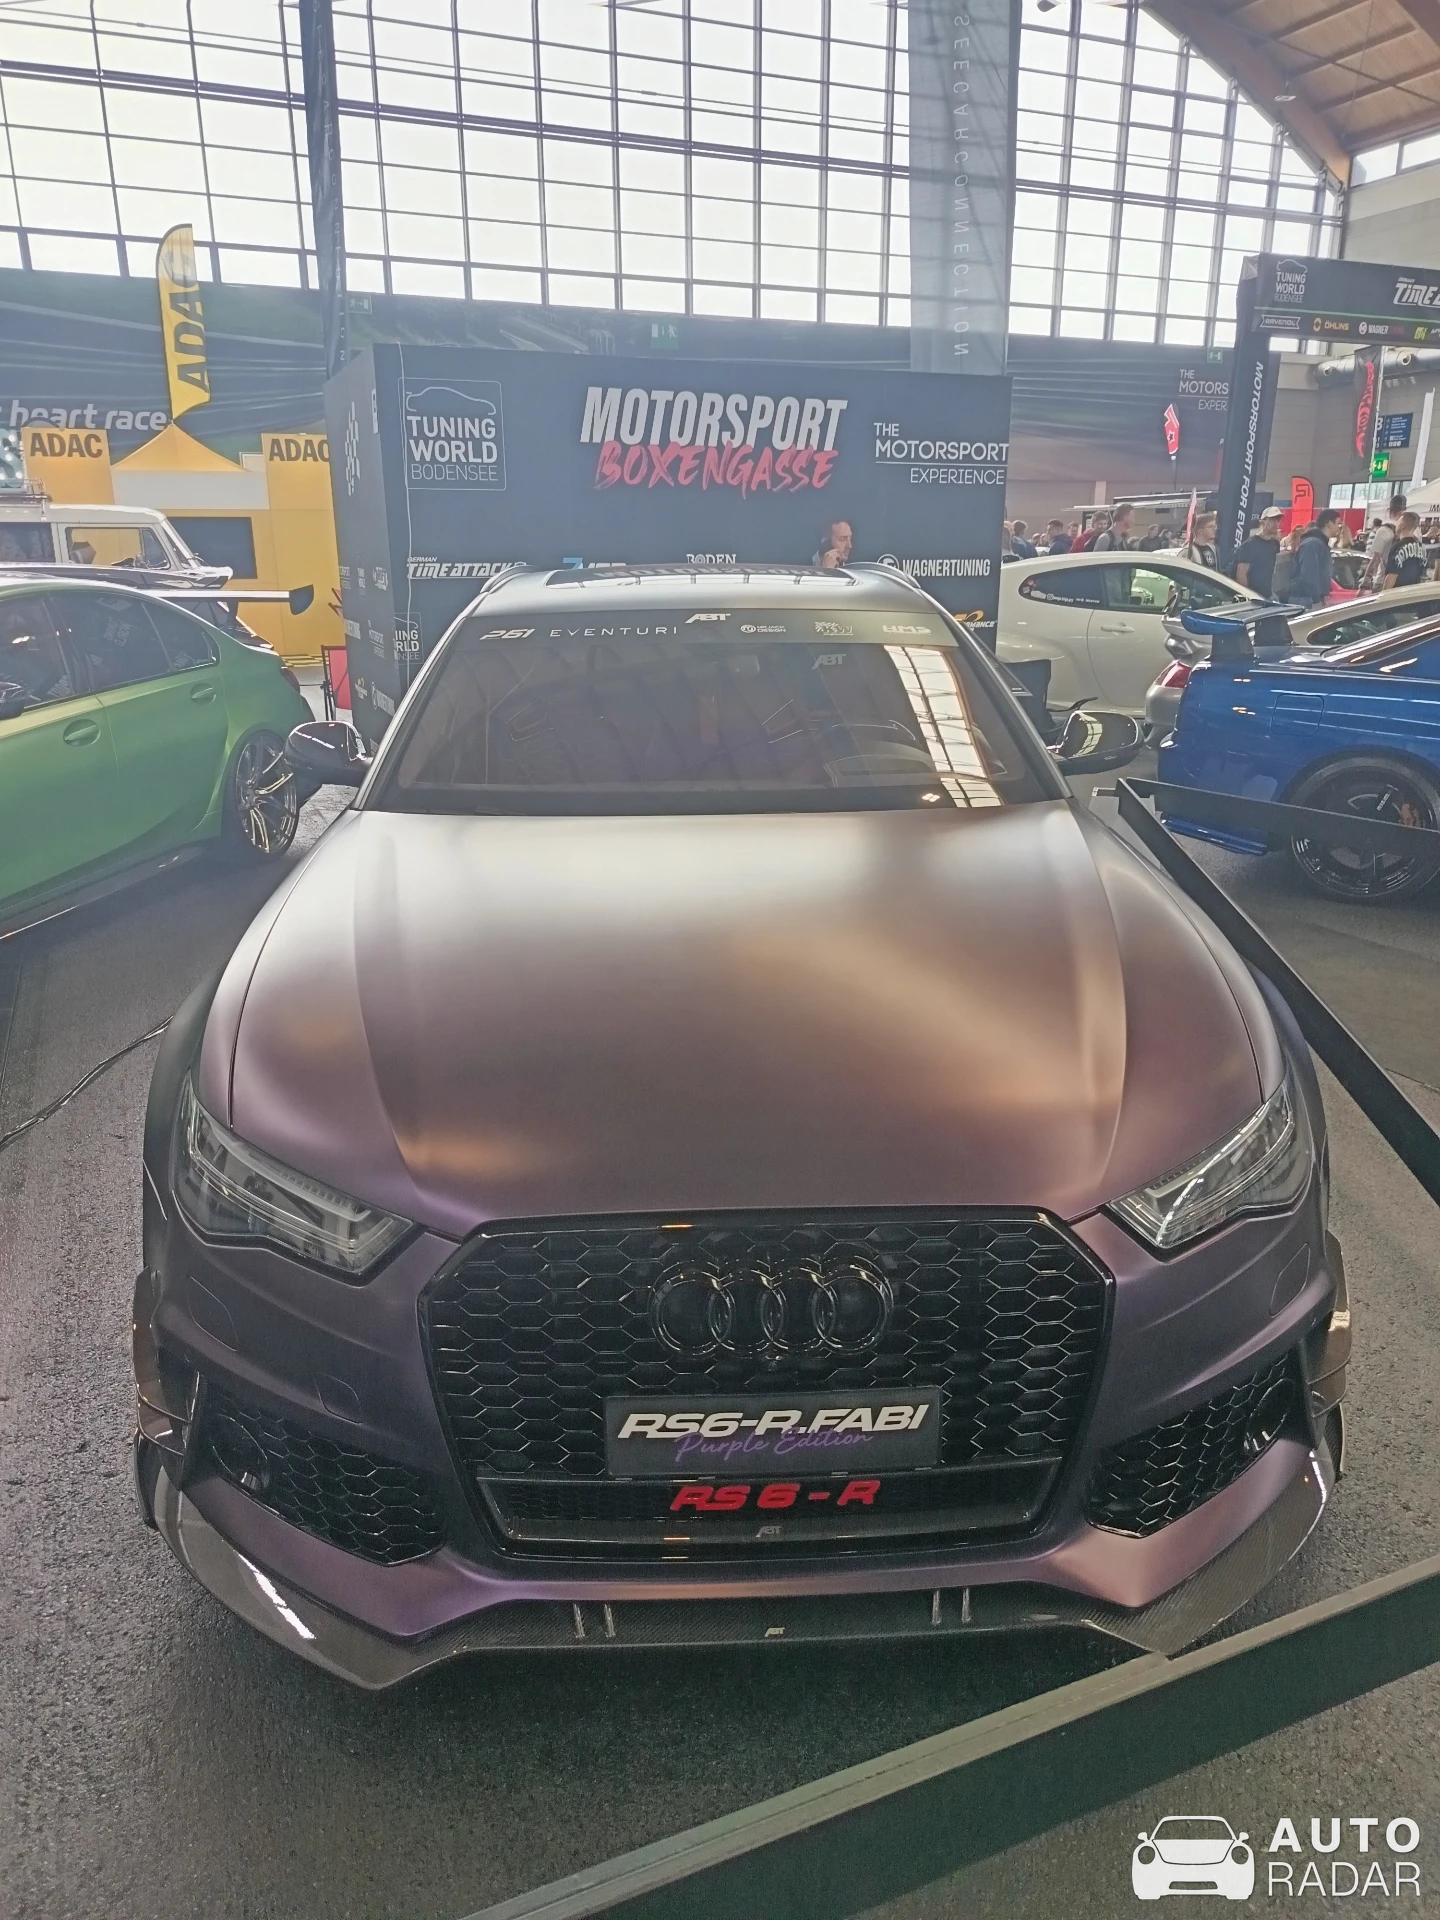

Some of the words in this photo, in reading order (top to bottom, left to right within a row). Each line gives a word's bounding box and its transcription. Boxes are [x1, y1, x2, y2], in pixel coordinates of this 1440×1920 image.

[1276, 272, 1306, 283] TUNING
[1275, 282, 1305, 294] WORLD
[162, 252, 209, 393] ADAC
[1179, 369, 1195, 379] THE
[1179, 380, 1229, 395] MOTORS
[9, 399, 98, 429] heart
[105, 410, 167, 431] race
[580, 386, 848, 451] MOTORSPORT
[1245, 361, 1264, 474] MOTORSPORT
[406, 415, 496, 439] TUNING
[874, 422, 900, 437] THE
[30, 433, 103, 458] ADAC
[409, 440, 498, 463] WORLD
[875, 439, 1009, 461] MOTORSPORT
[411, 464, 498, 481] BODENSEE
[593, 440, 838, 499] BOXENGASSE
[910, 468, 1005, 485] EXPERIENCE
[1240, 476, 1251, 509] FOR
[902, 559, 991, 577] WAGNERTUNING
[685, 613, 731, 624] ABT
[550, 626, 677, 637] EVENTURI
[811, 653, 847, 670] ABT
[617, 1404, 929, 1439] RS6-R.FABI
[674, 1431, 773, 1463] Purple
[774, 1426, 874, 1455] Edition
[755, 1525, 782, 1538] ABT
